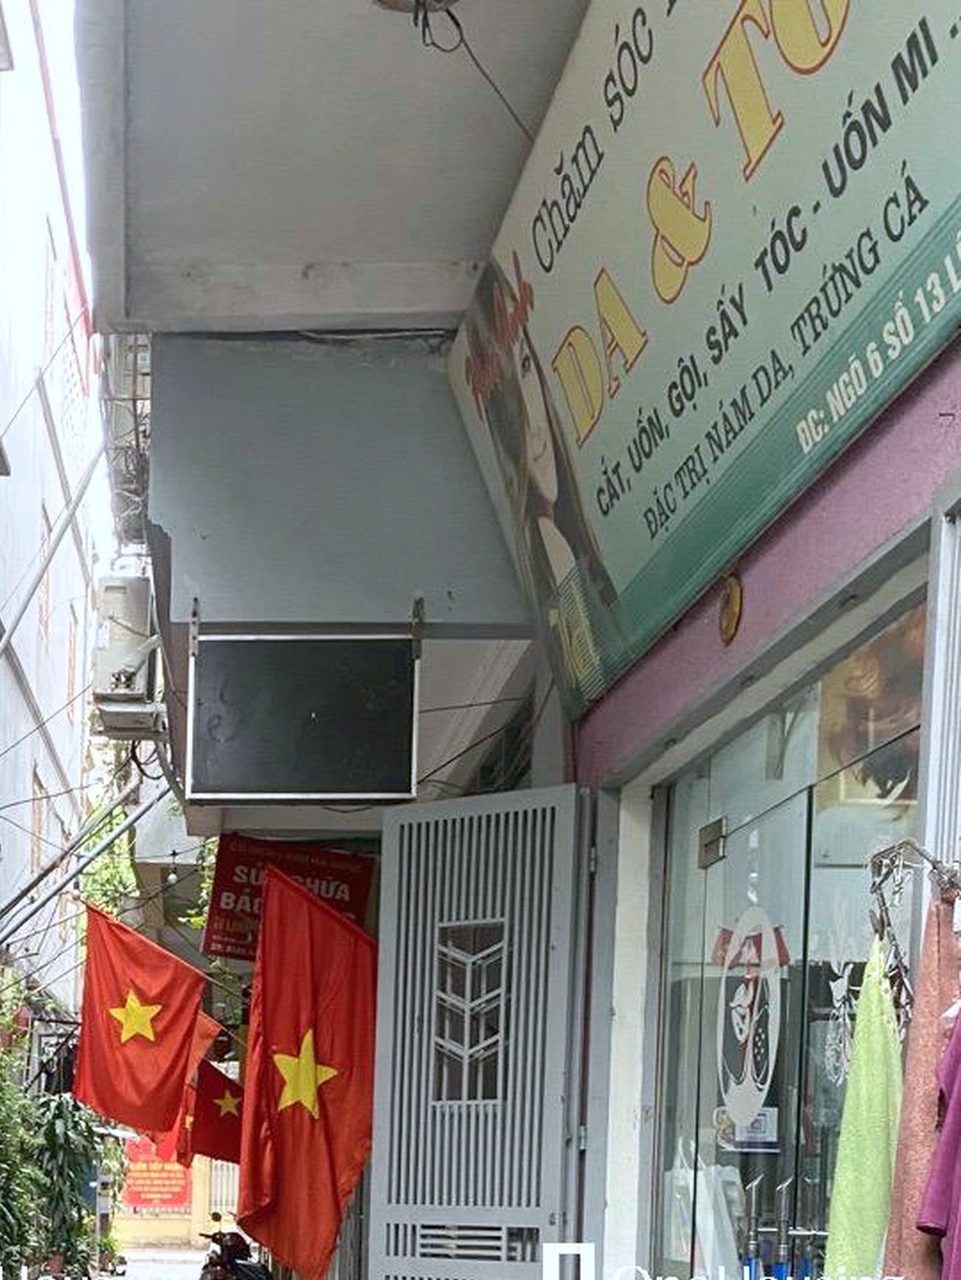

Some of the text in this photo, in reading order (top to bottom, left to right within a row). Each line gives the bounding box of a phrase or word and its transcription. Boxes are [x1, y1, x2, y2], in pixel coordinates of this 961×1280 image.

[532, 125, 604, 273] Chăm
[551, 266, 649, 449] DA
[646, 155, 712, 304] &
[595, 455, 632, 517] CẮT,
[627, 406, 670, 473] UỐN,
[666, 354, 708, 419] GỘI,
[705, 283, 749, 365] SẤY
[754, 204, 808, 292] TÓC
[821, 82, 892, 198] UỐN
[891, 16, 939, 106] MI
[674, 444, 711, 500] TRỊ
[705, 383, 756, 464] NÁM
[751, 349, 795, 407] DA,
[882, 159, 930, 242] CÁ
[825, 353, 868, 423] NGÕ
[866, 342, 884, 378] 6
[882, 290, 915, 360] SỐ
[914, 271, 946, 324] 13
